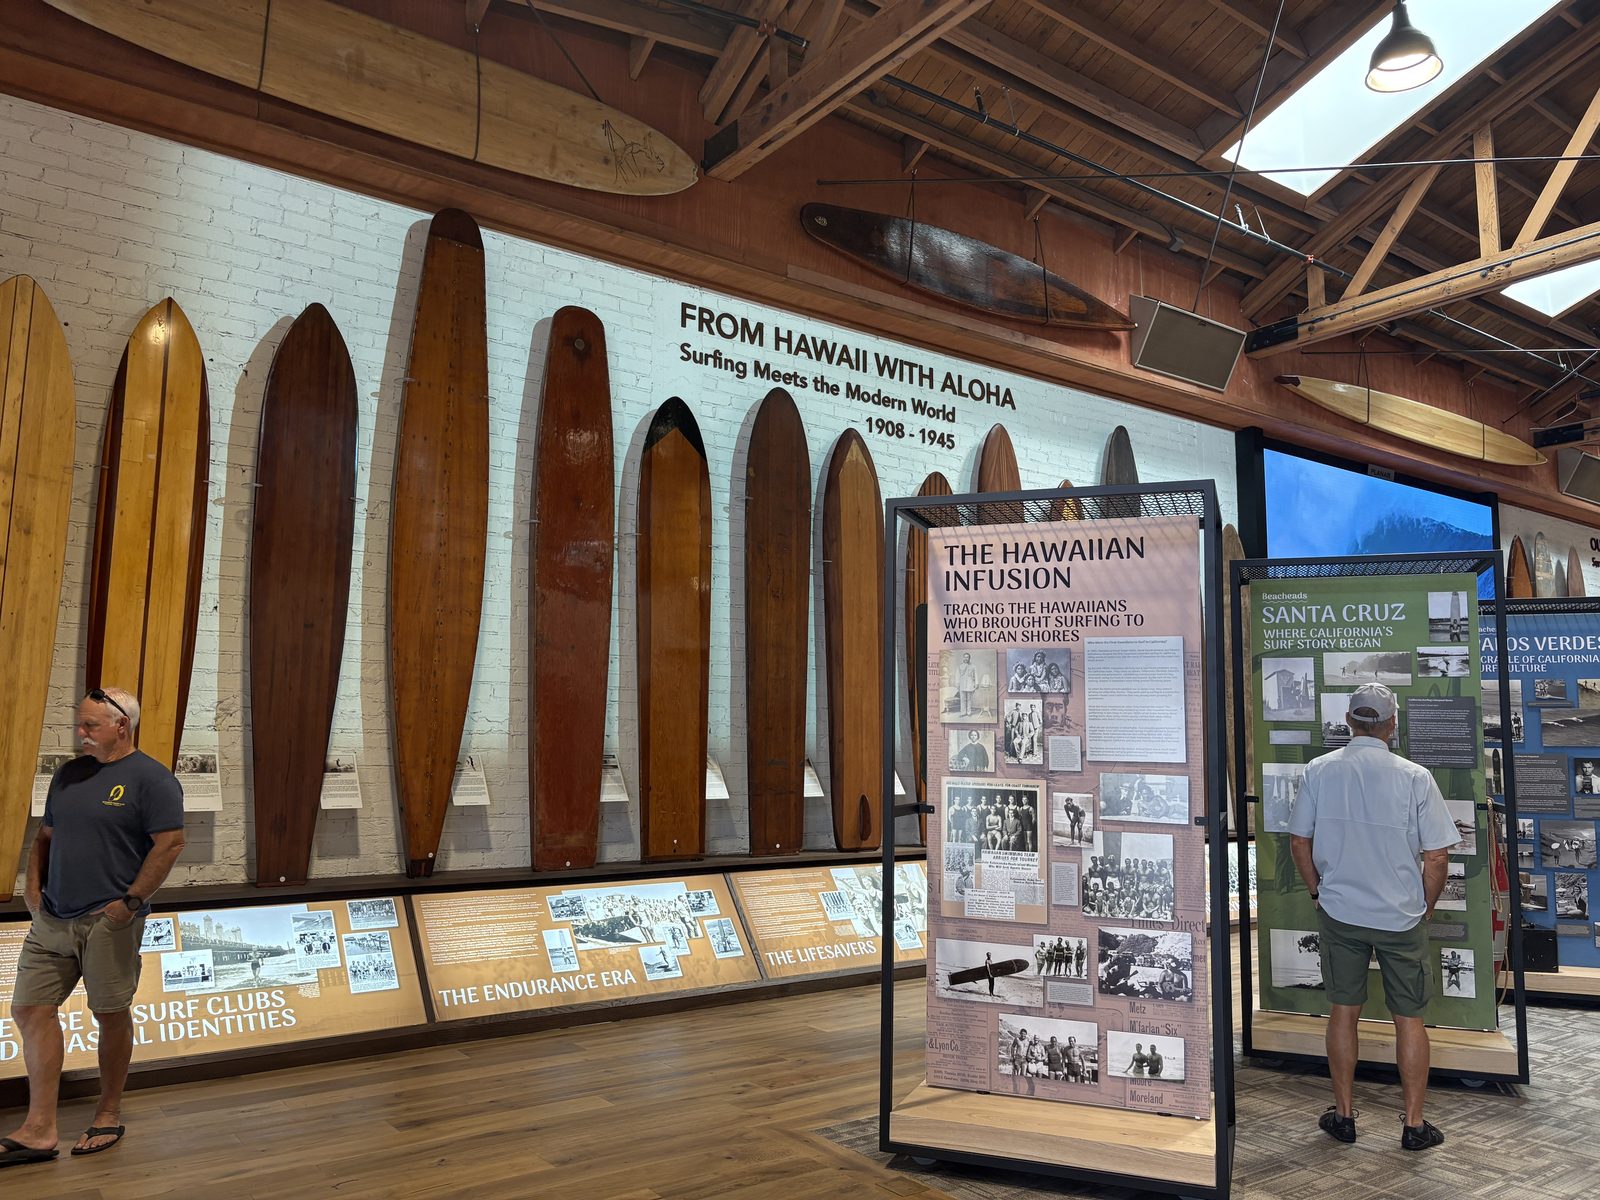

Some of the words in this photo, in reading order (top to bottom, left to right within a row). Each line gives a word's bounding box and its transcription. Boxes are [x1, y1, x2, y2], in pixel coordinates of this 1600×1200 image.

[681, 301, 764, 347] FROM
[774, 326, 868, 374] HAWAII
[874, 352, 934, 390] WITH
[940, 371, 1016, 410] ALOHA
[680, 342, 748, 380] Surfing
[754, 360, 808, 388] Meets
[812, 375, 840, 396] the
[846, 382, 907, 412] Modern
[911, 398, 956, 423] World
[866, 416, 906, 439] 1908
[919, 428, 956, 450] 1945
[944, 544, 994, 566] THE
[1002, 536, 1145, 564] HAWAIIAN
[945, 566, 1071, 592] INFUSION
[1262, 592, 1308, 600] Beacheads
[944, 602, 1004, 616] TRACING
[1008, 602, 1036, 614] THE
[1040, 600, 1127, 614] HAWAIIANS
[1262, 604, 1337, 624] SANTA
[1342, 602, 1406, 622] CRUZ
[944, 616, 978, 630] WHO
[982, 616, 1050, 629] BROUGHT
[1054, 614, 1120, 628] SURFING
[1124, 614, 1144, 626] TO
[944, 630, 1017, 643] AMERICAN
[1020, 630, 1080, 642] SHORES
[1264, 628, 1307, 639] WHERE
[1309, 626, 1394, 638] CALIFORNIA'S
[1264, 640, 1298, 650] SURF
[1298, 638, 1337, 649] STORY
[1339, 638, 1381, 648] BEGAN
[1479, 636, 1530, 652] AOS
[1534, 636, 1600, 651] VERDE
[1480, 655, 1520, 664] CRALE
[1522, 655, 1535, 664] OF
[1480, 664, 1498, 672] URF
[1508, 664, 1547, 672] ULTURE
[765, 950, 796, 966] THE
[796, 940, 877, 962] LIFESAVERS
[438, 986, 480, 1007] THE
[483, 973, 598, 1002] ENDURANCE
[601, 968, 637, 987] ERA
[132, 999, 200, 1024] SURF
[206, 989, 286, 1016] CLUBS
[1130, 1002, 1146, 1014] Metz
[160, 1008, 297, 1042] IDENTITIES
[1130, 1090, 1164, 1105] Moreland
